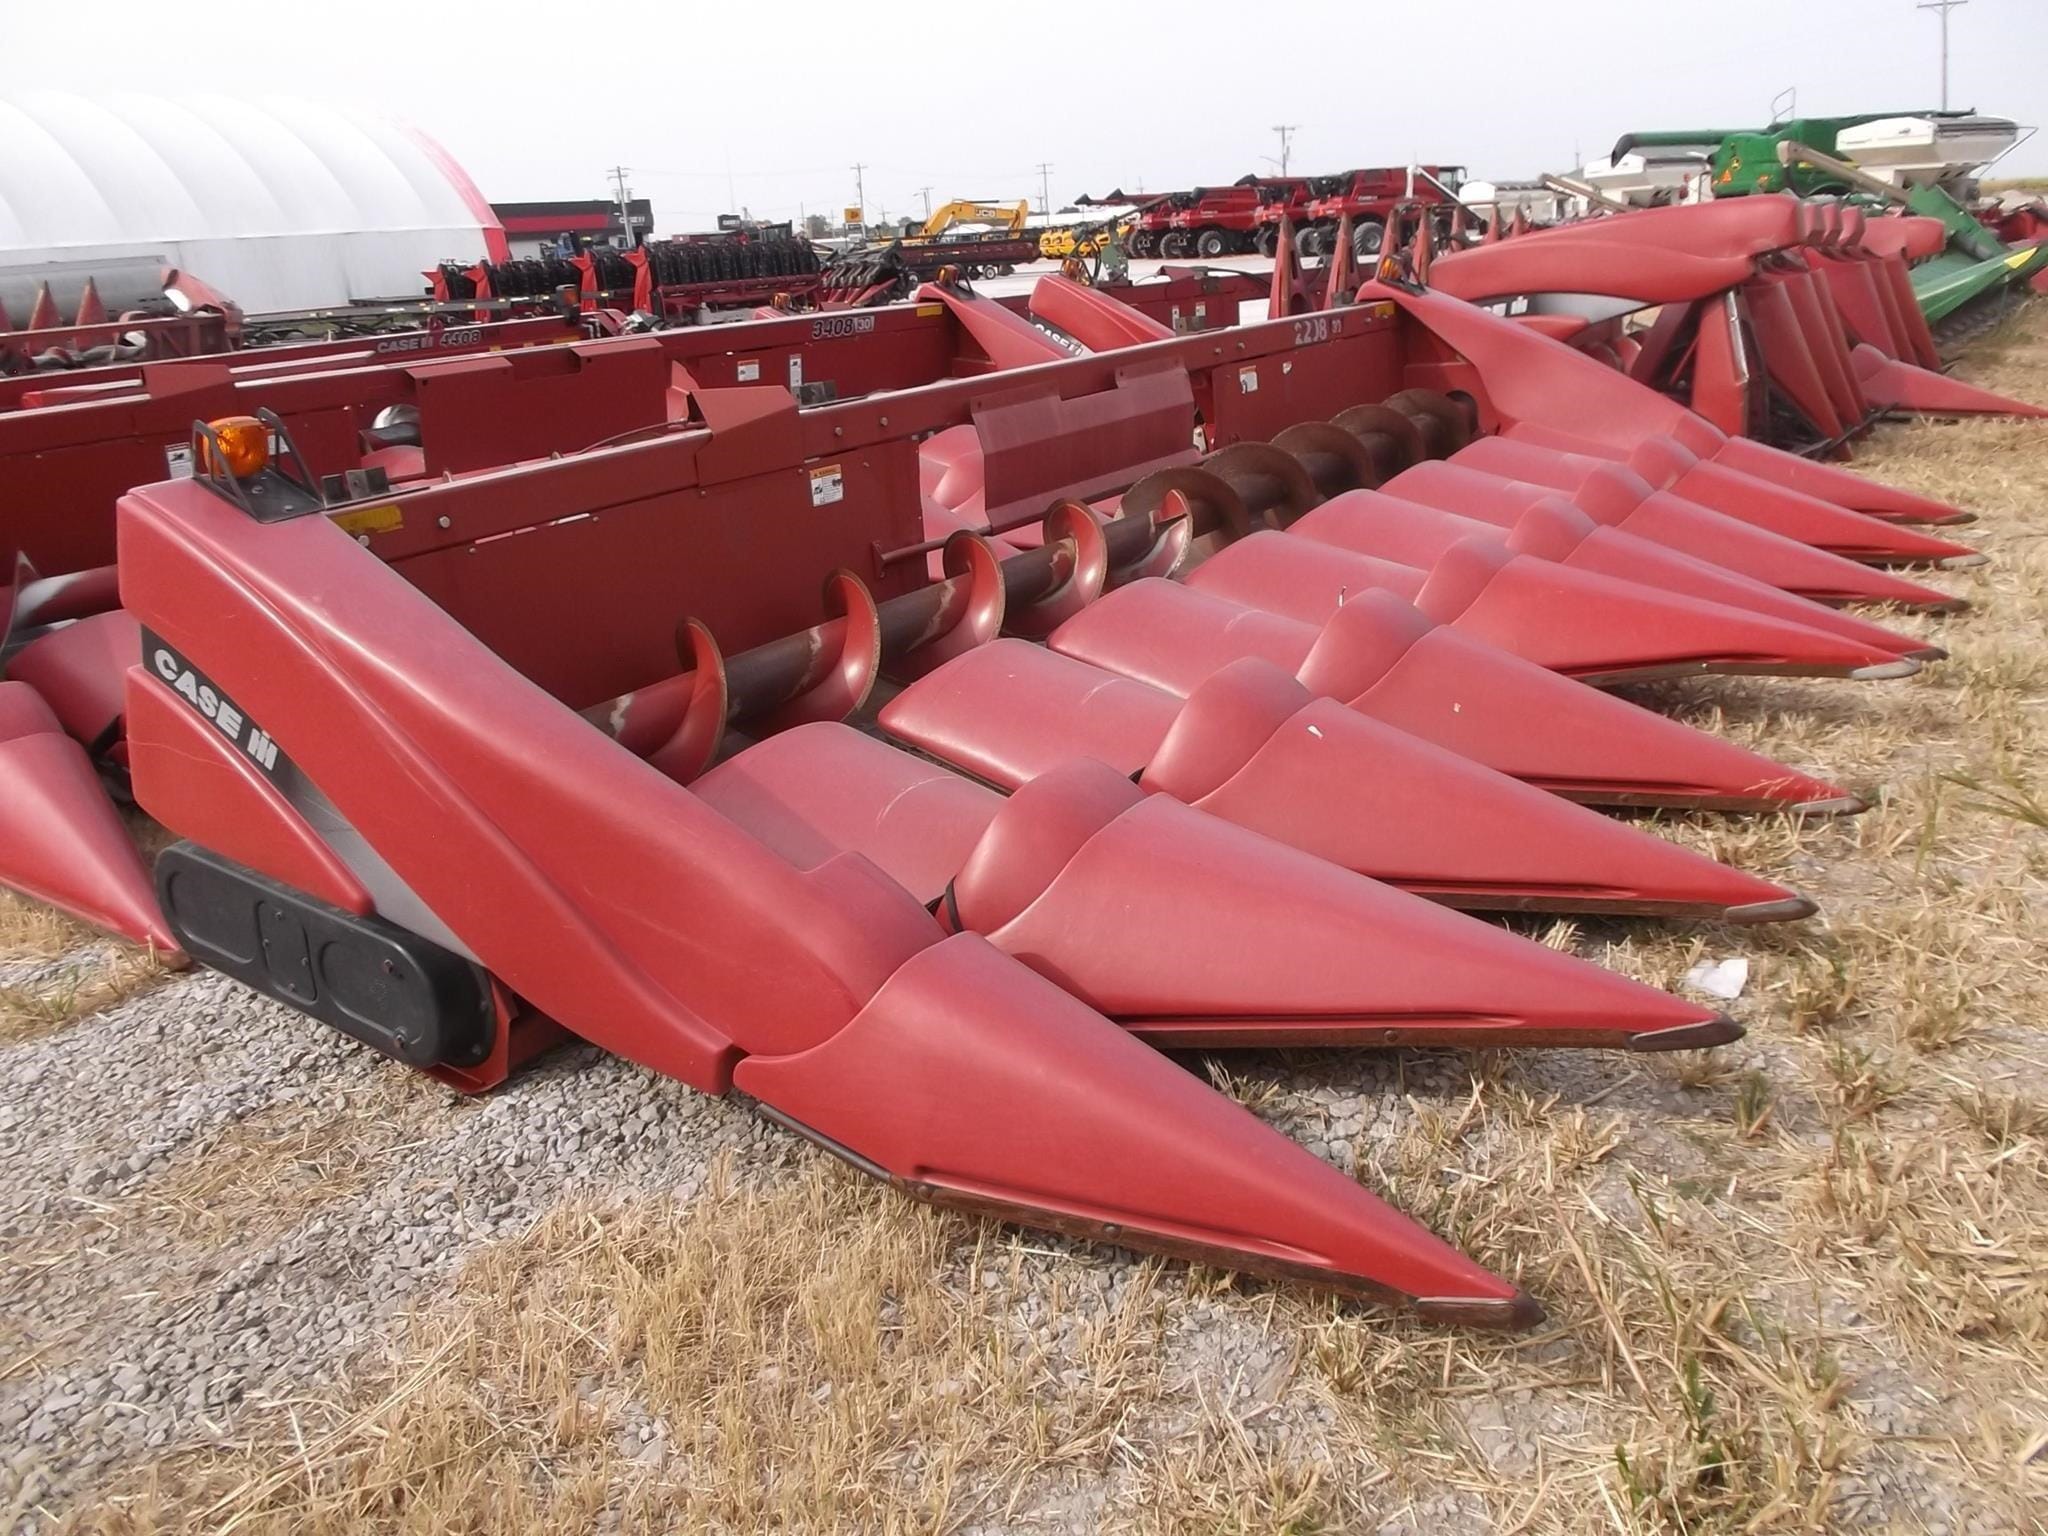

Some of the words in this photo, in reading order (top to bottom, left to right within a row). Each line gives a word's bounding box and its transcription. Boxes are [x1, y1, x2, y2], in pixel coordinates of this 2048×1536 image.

[812, 317, 854, 339] 3408
[857, 316, 873, 331] 30
[377, 338, 419, 353] CASE
[440, 329, 481, 346] 4408
[154, 649, 243, 740] CASE
